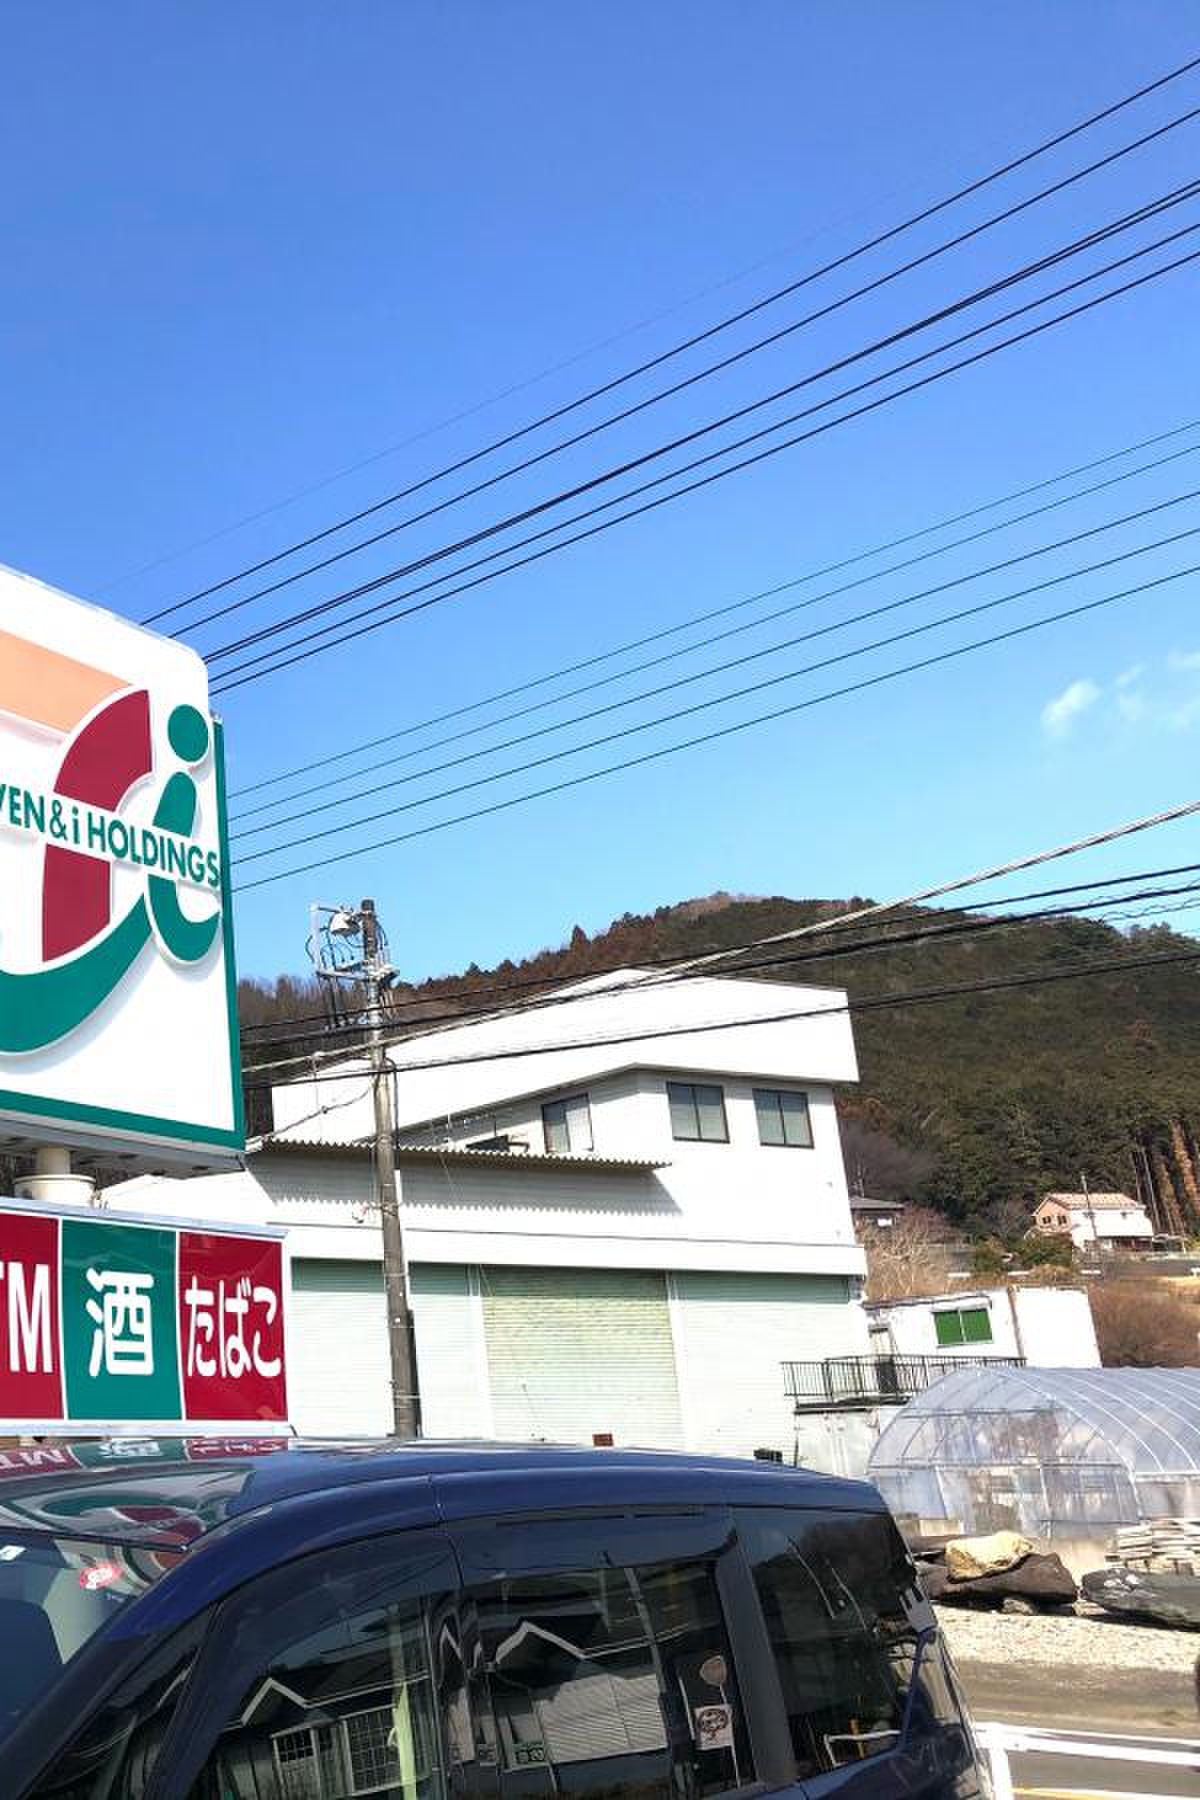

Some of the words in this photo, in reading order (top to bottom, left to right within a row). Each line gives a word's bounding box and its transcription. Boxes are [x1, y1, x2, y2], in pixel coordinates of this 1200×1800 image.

[87, 811, 221, 887] HOLDINGS
[86, 1267, 155, 1377] 酒
[185, 1275, 282, 1378] たばこ
